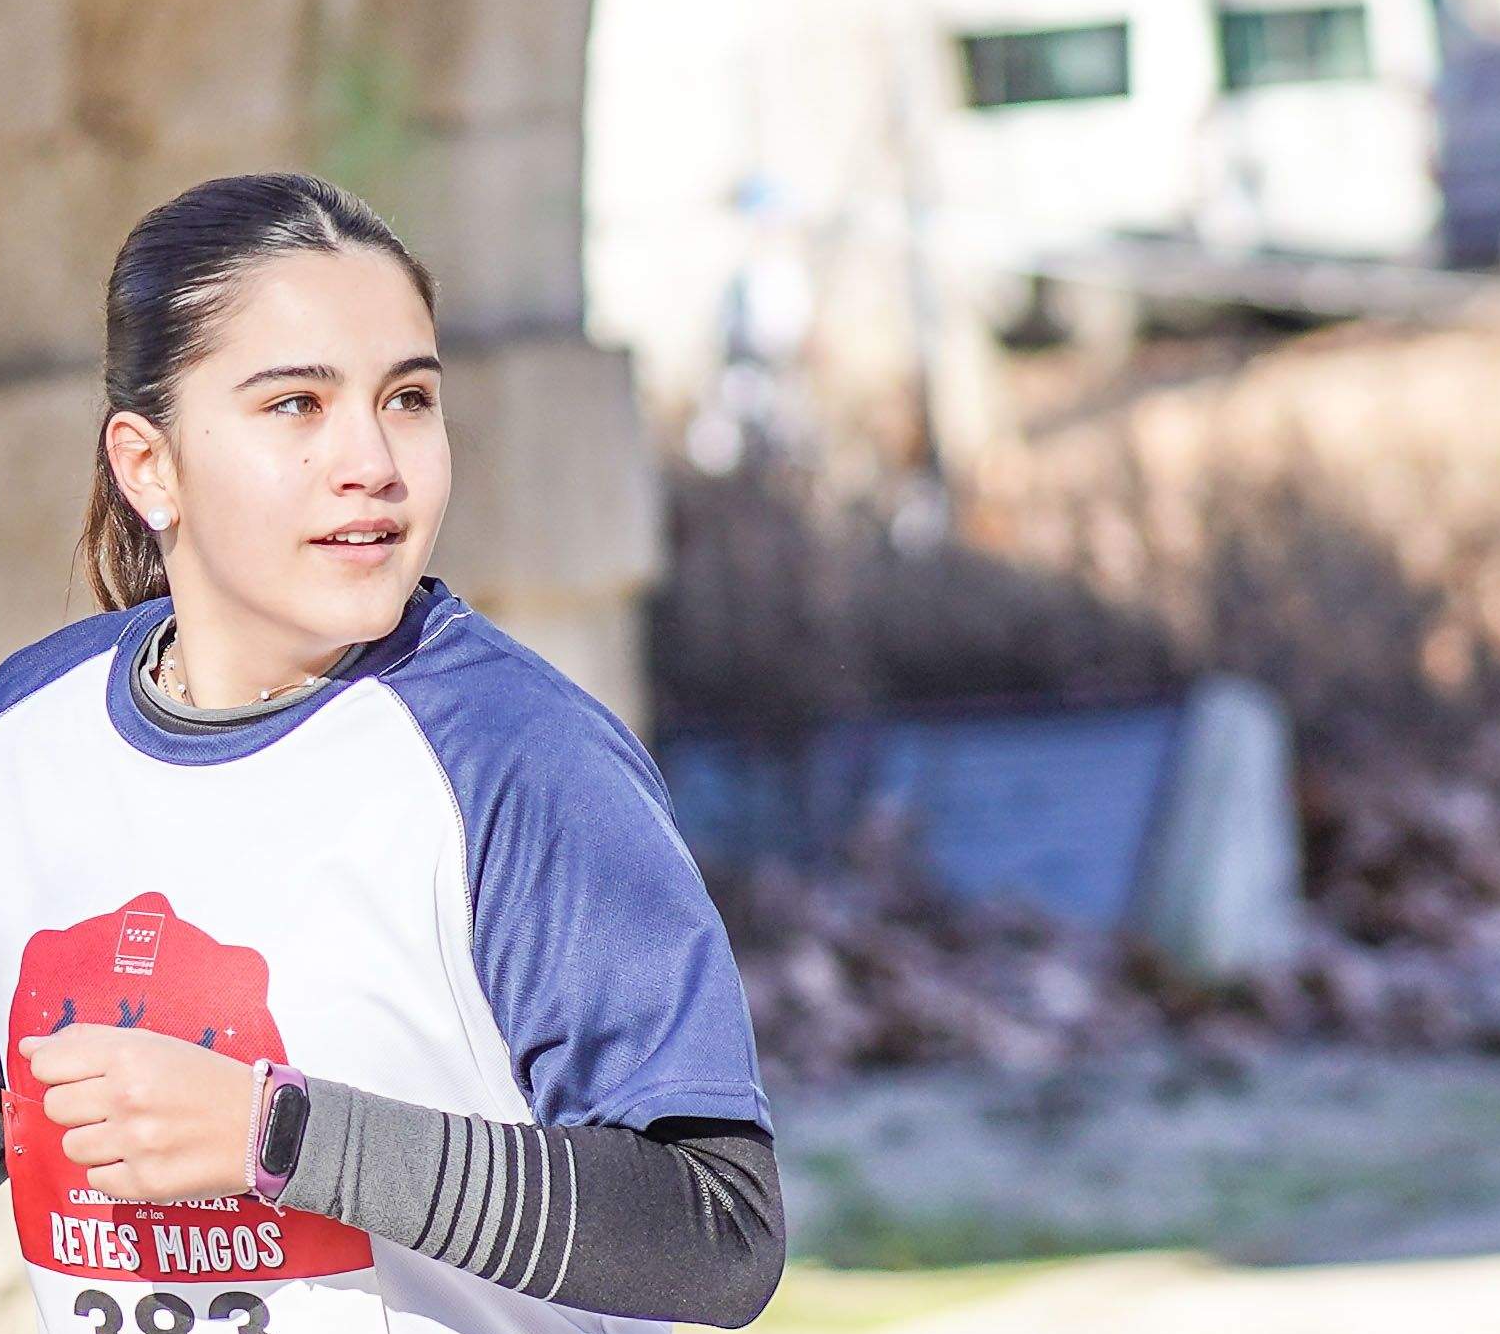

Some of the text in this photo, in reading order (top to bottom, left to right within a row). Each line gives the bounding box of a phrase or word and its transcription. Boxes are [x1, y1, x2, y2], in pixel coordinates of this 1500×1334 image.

[135, 1208, 165, 1220] de los
[50, 1211, 285, 1274] REYES MAGOS
